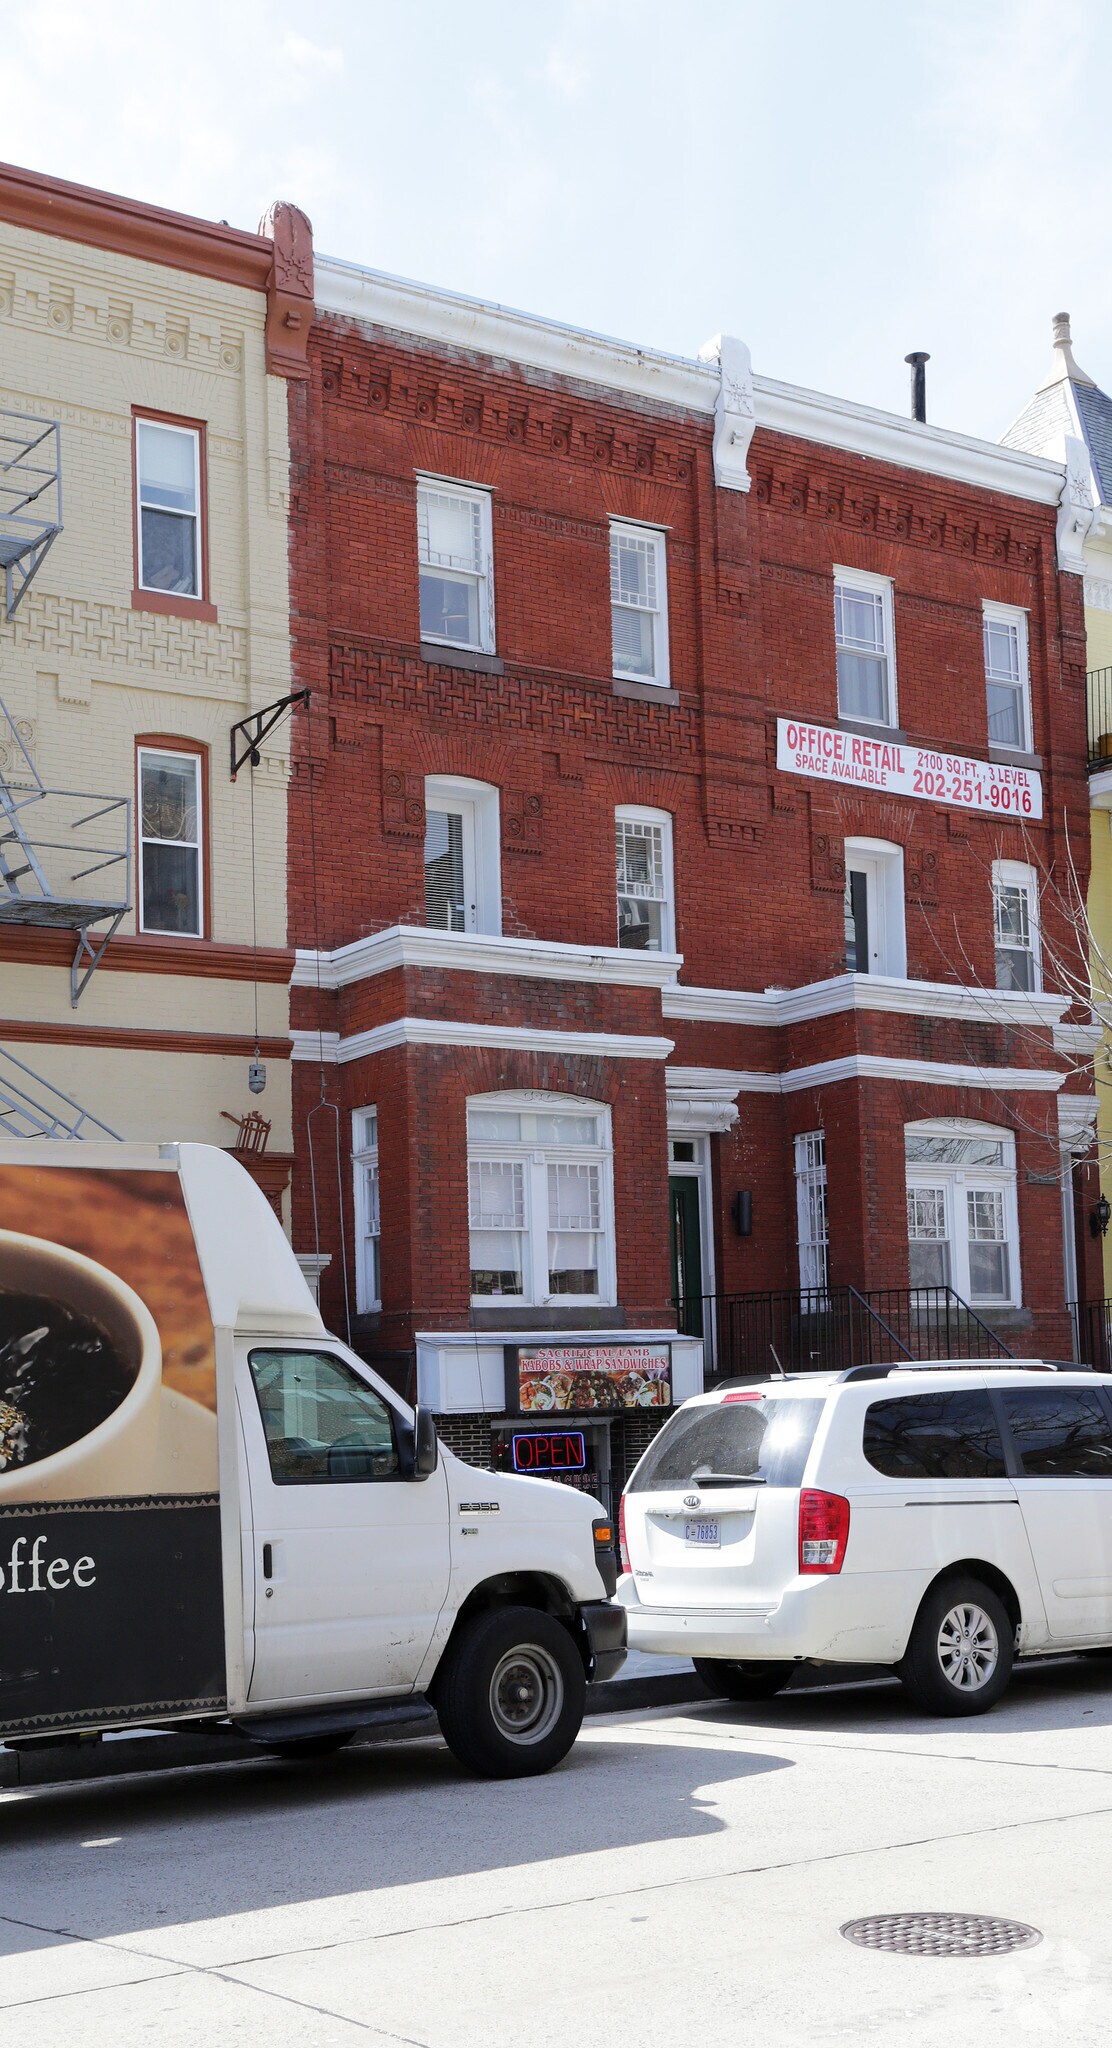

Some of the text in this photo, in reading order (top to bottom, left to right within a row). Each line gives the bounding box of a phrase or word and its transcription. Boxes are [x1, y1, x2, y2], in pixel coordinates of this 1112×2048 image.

[787, 723, 905, 774] OFFICE/ RETAIL
[795, 753, 887, 787] SPACE AVAILABLE
[917, 751, 943, 771] 2100
[989, 766, 996, 781] 3
[998, 767, 1030, 788] LEVEL
[913, 769, 1032, 813] 202-251-9016
[521, 1357, 666, 1371] KABOBS & WRAP SANDWICHES
[538, 1347, 650, 1358] SACRIFICIAL LAMB
[515, 1436, 582, 1467] OPEN
[684, 1496, 699, 1507] KIA
[0, 1535, 97, 1594] ffee
